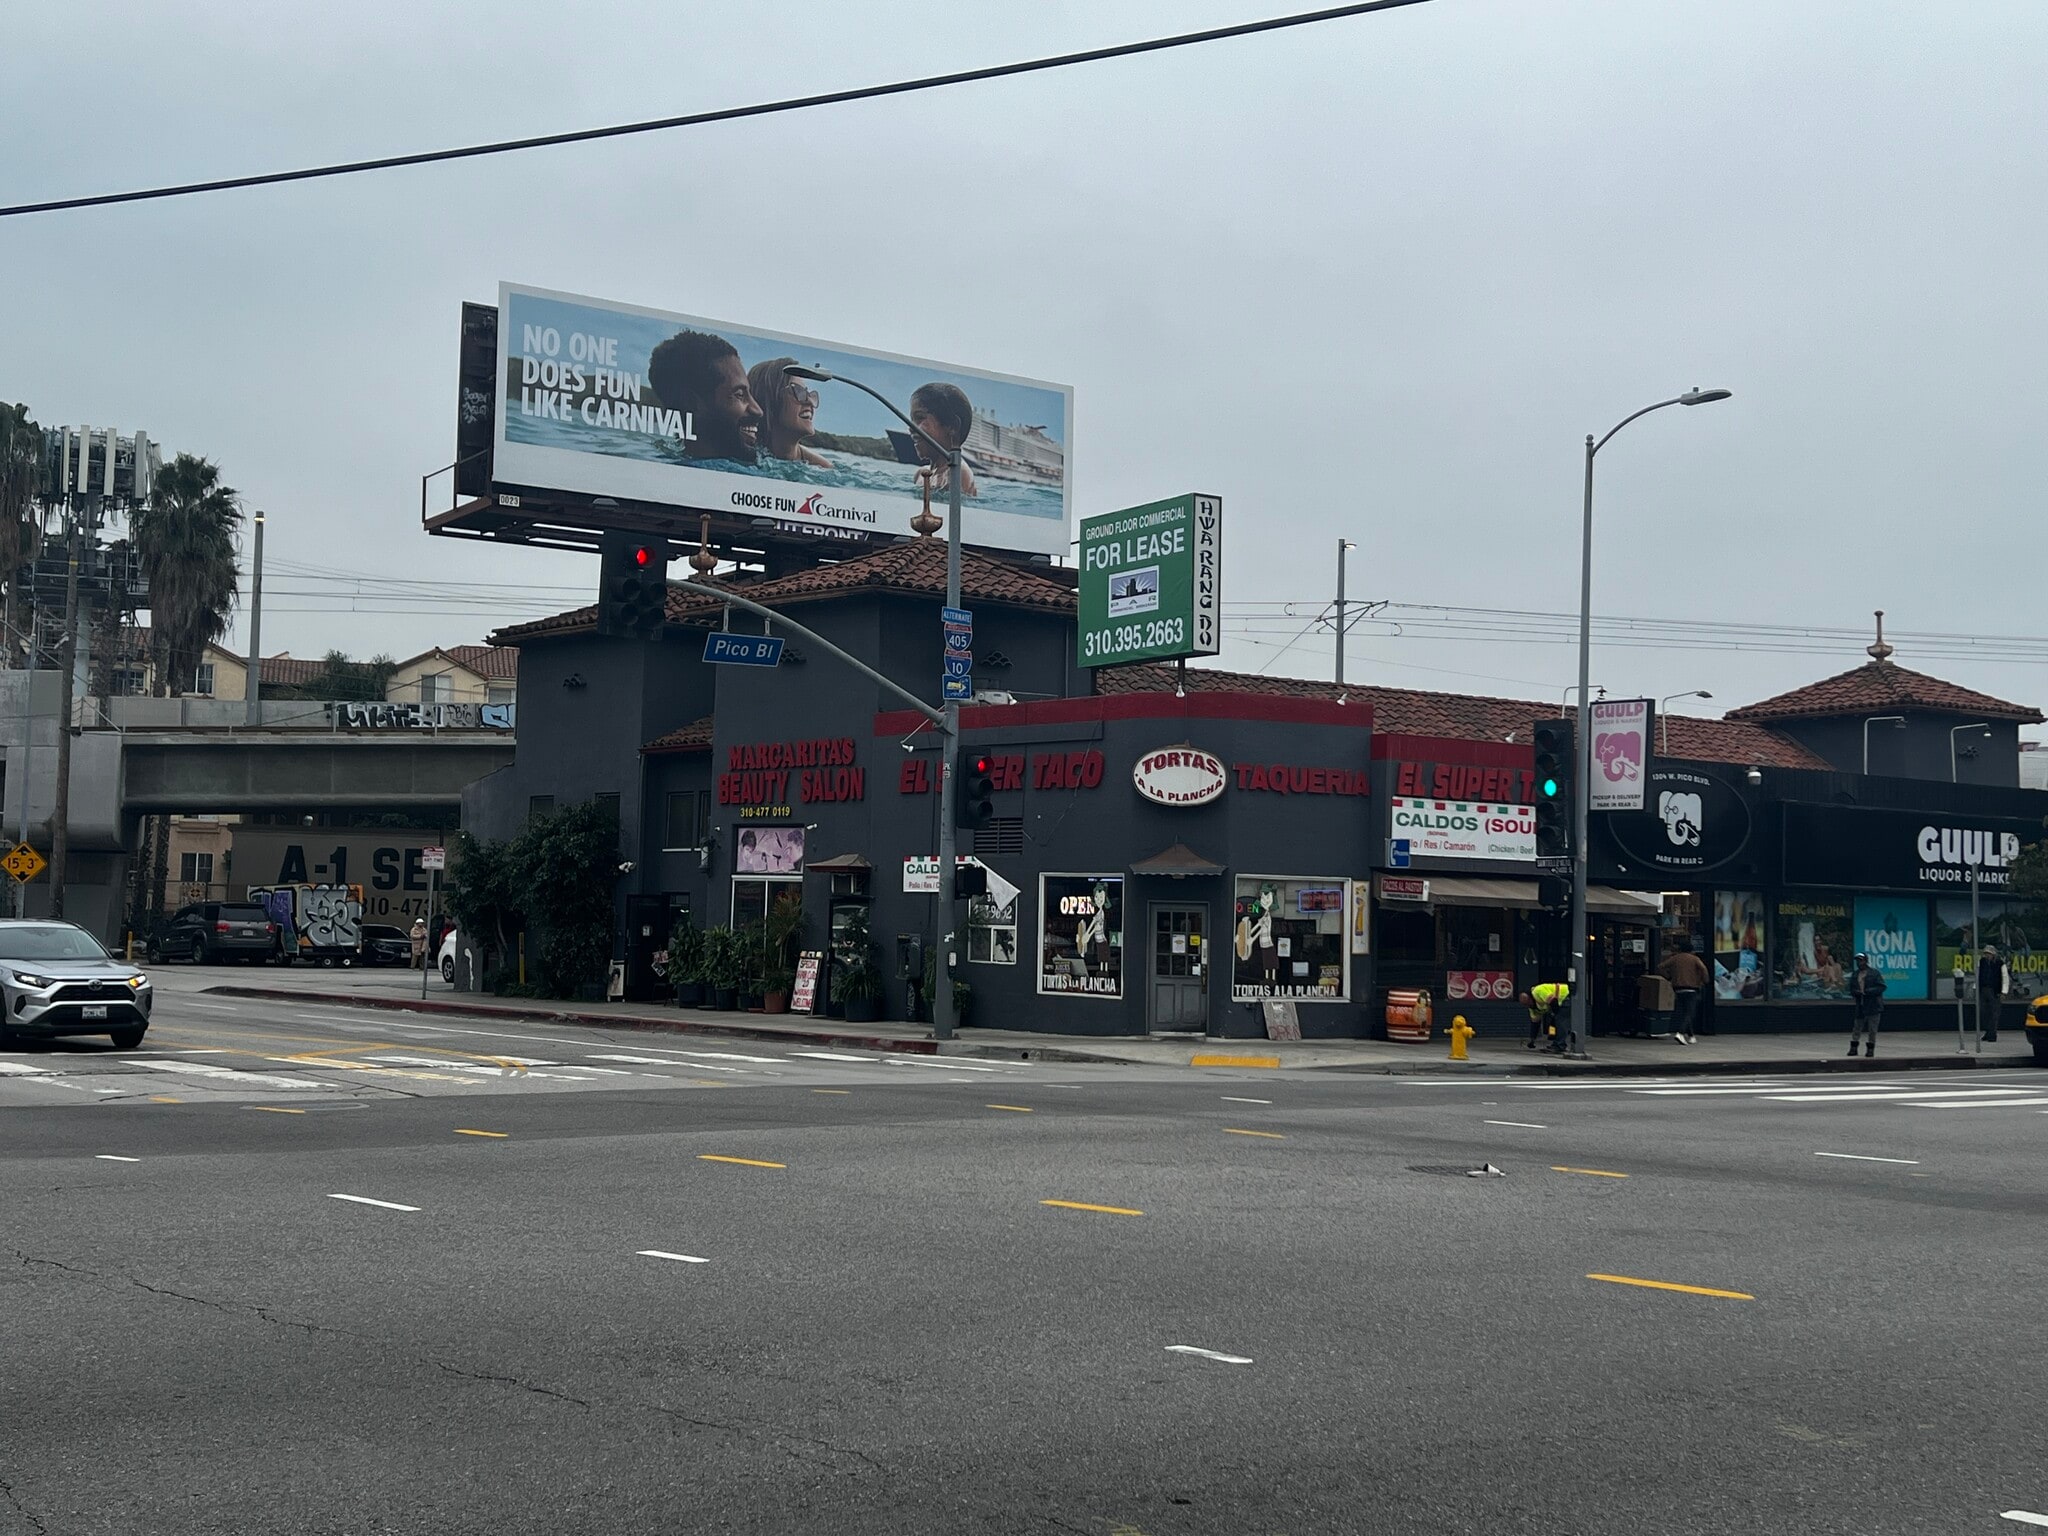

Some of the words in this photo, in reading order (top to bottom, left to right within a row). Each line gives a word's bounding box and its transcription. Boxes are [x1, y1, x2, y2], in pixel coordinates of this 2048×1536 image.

[523, 324, 561, 357] NO
[569, 332, 618, 367] ONE
[522, 355, 586, 392] DOES
[595, 367, 641, 401] FUN
[521, 387, 573, 422] LIKE
[581, 396, 697, 441] CARNIVAL
[500, 495, 519, 506] 0023
[731, 491, 772, 510] CHOOSE
[775, 498, 796, 512] FUN
[815, 502, 877, 523] Carnival
[1086, 523, 1114, 541] GROUND
[1115, 517, 1138, 533] FLOOR
[1139, 506, 1186, 529] COMMERCIAL
[1199, 501, 1215, 547] HWA
[1086, 541, 1121, 571] FOR
[1126, 527, 1185, 563] LEASE
[1200, 550, 1214, 609] RANG
[944, 610, 971, 623] ALTERNATE
[1085, 617, 1184, 657] 310.395.2663
[1199, 614, 1212, 646] DO
[714, 639, 749, 657] Pico
[756, 644, 774, 659] Bl
[949, 635, 967, 647] 405
[952, 662, 963, 674] 10
[1594, 703, 1644, 719] GUULP
[728, 737, 855, 771] MARGARITAS
[1142, 752, 1220, 777] TORTAS
[900, 759, 930, 794] EL
[1032, 750, 1105, 789] TACO
[1233, 763, 1370, 796] TAQUERIA
[1397, 762, 1426, 798] EL
[1432, 763, 1514, 803] SUPER
[718, 771, 791, 804] BEAUTY
[801, 767, 865, 804] SALON
[1137, 777, 1146, 788] A
[1150, 786, 1164, 799] LA
[1167, 779, 1223, 802] PLANCHA
[740, 806, 769, 818] 310-477
[772, 806, 791, 817] 0119
[1395, 812, 1479, 831] CALDOS
[1423, 839, 1438, 849] Res
[1519, 845, 1534, 855] Beef
[1917, 826, 2019, 867] GUULP
[277, 845, 348, 885] A-1
[907, 863, 940, 874] CALD
[1655, 854, 1672, 863] PARK
[1919, 867, 1961, 882] LIQUOR
[1964, 870, 1971, 883] &
[1060, 896, 1095, 915] OPEN
[1778, 903, 1808, 916] BRING
[1815, 904, 1846, 917] ALOHA
[1864, 928, 1917, 954] KONA
[1885, 954, 1918, 969] WAVE
[2012, 954, 2048, 974] ALOH
[1043, 974, 1068, 989] TORTAS
[1080, 976, 1117, 993] PLANCHA
[1234, 984, 1271, 997] TORTAS
[1274, 985, 1281, 997] A
[1281, 985, 1293, 997] LA
[1296, 985, 1337, 998] PLANCHA
